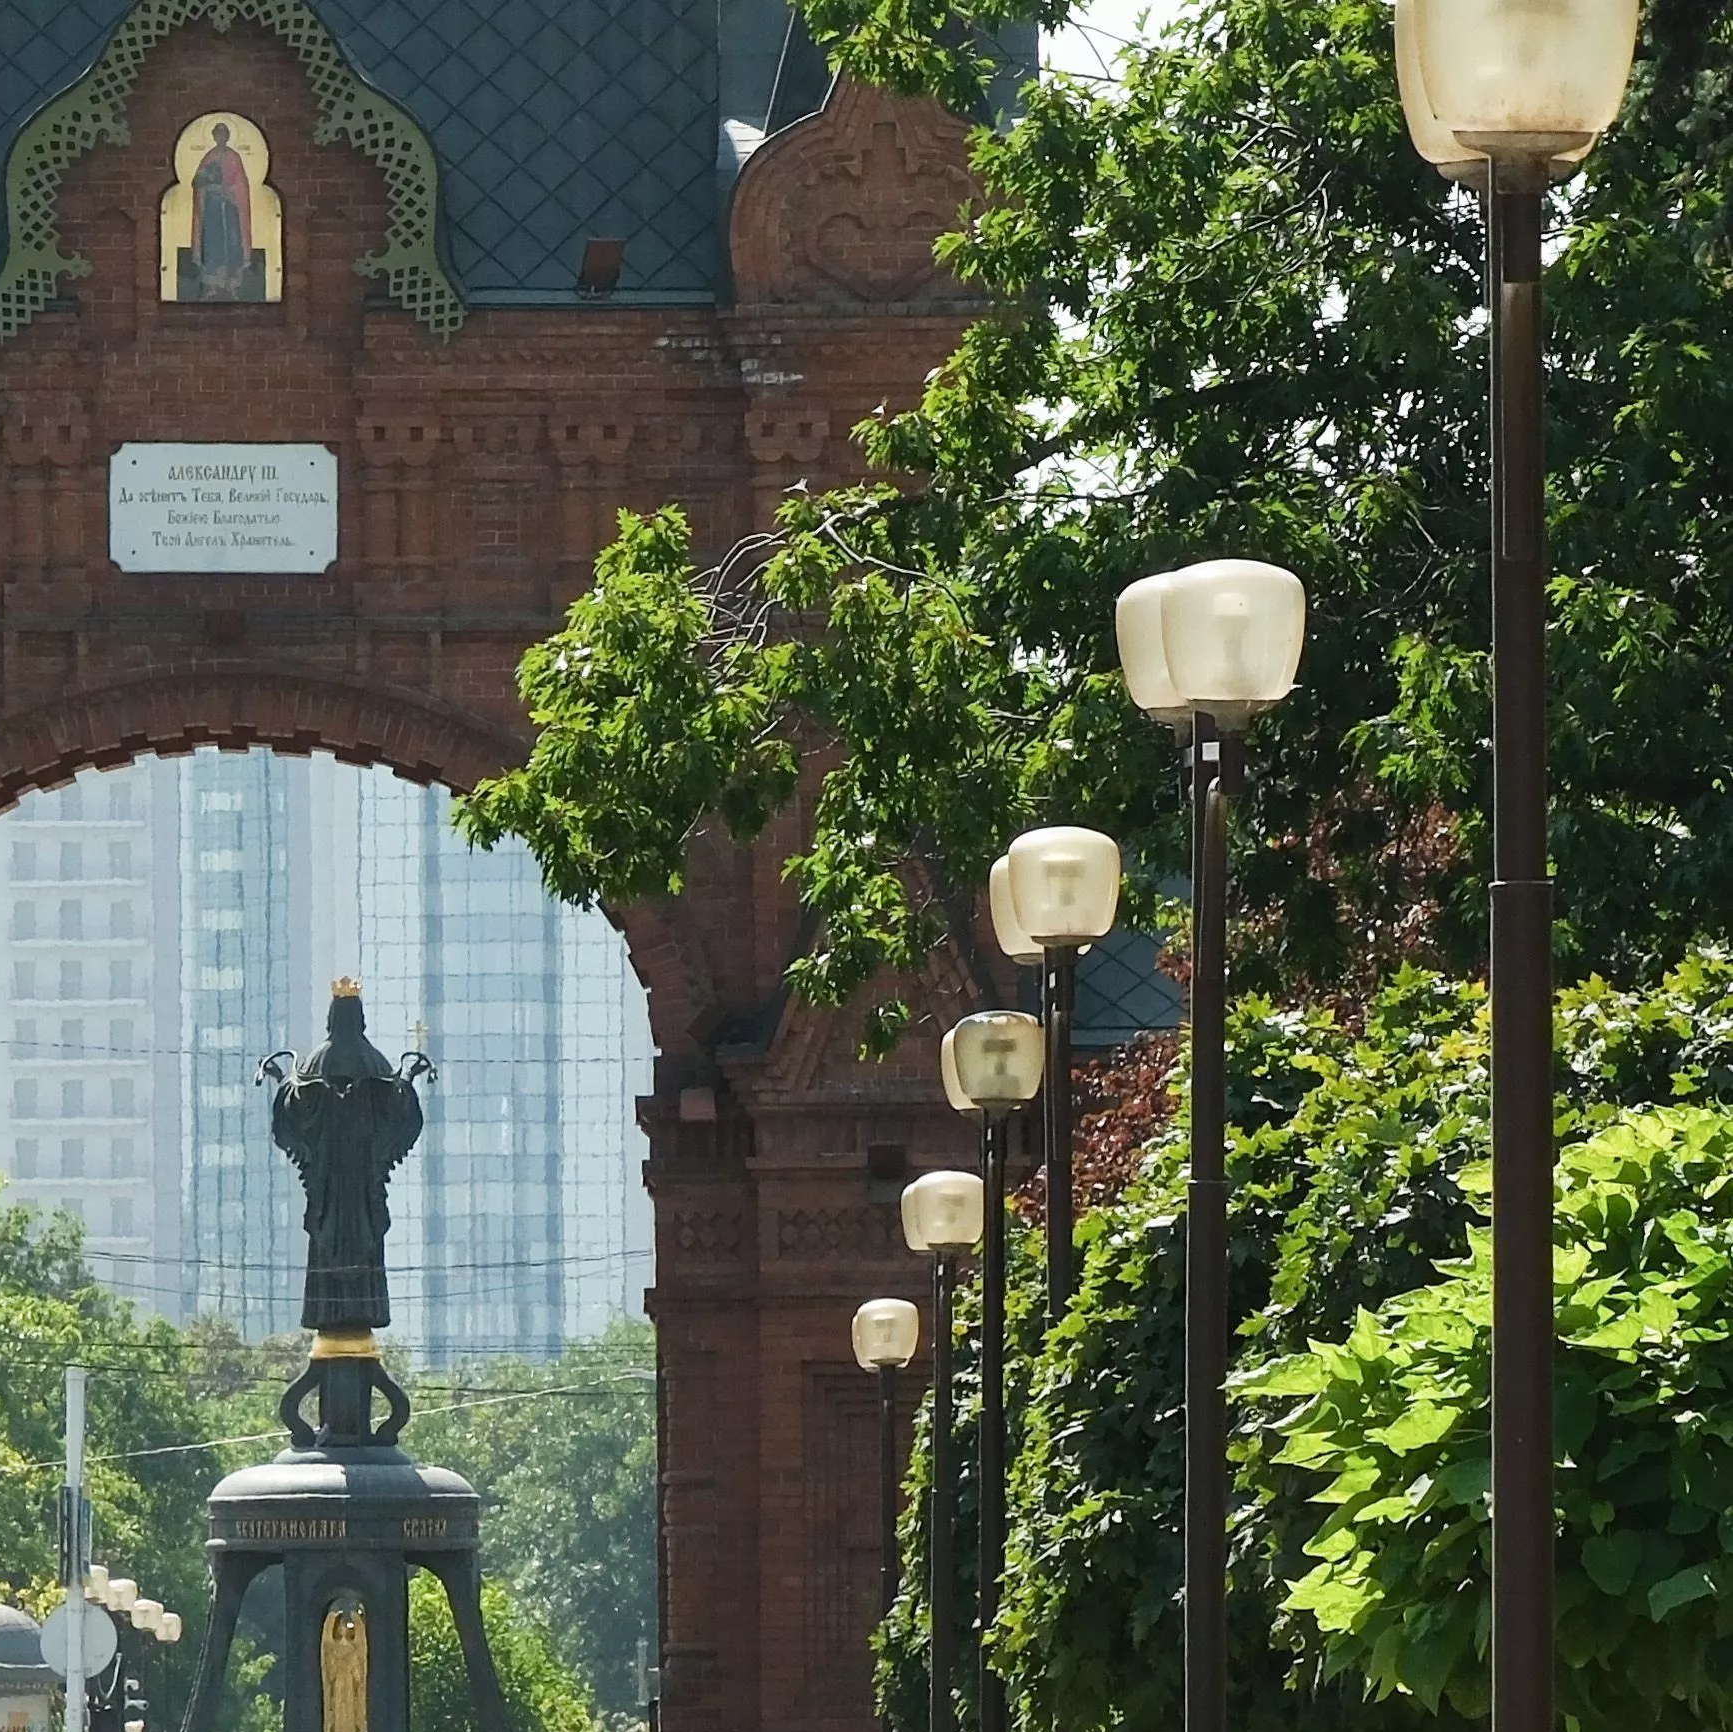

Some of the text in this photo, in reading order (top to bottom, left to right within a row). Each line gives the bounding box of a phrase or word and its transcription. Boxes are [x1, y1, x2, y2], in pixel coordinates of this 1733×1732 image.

[167, 464, 257, 484] АЛЕКСАНДРУ
[118, 486, 134, 505] Да
[151, 530, 181, 547] Твой
